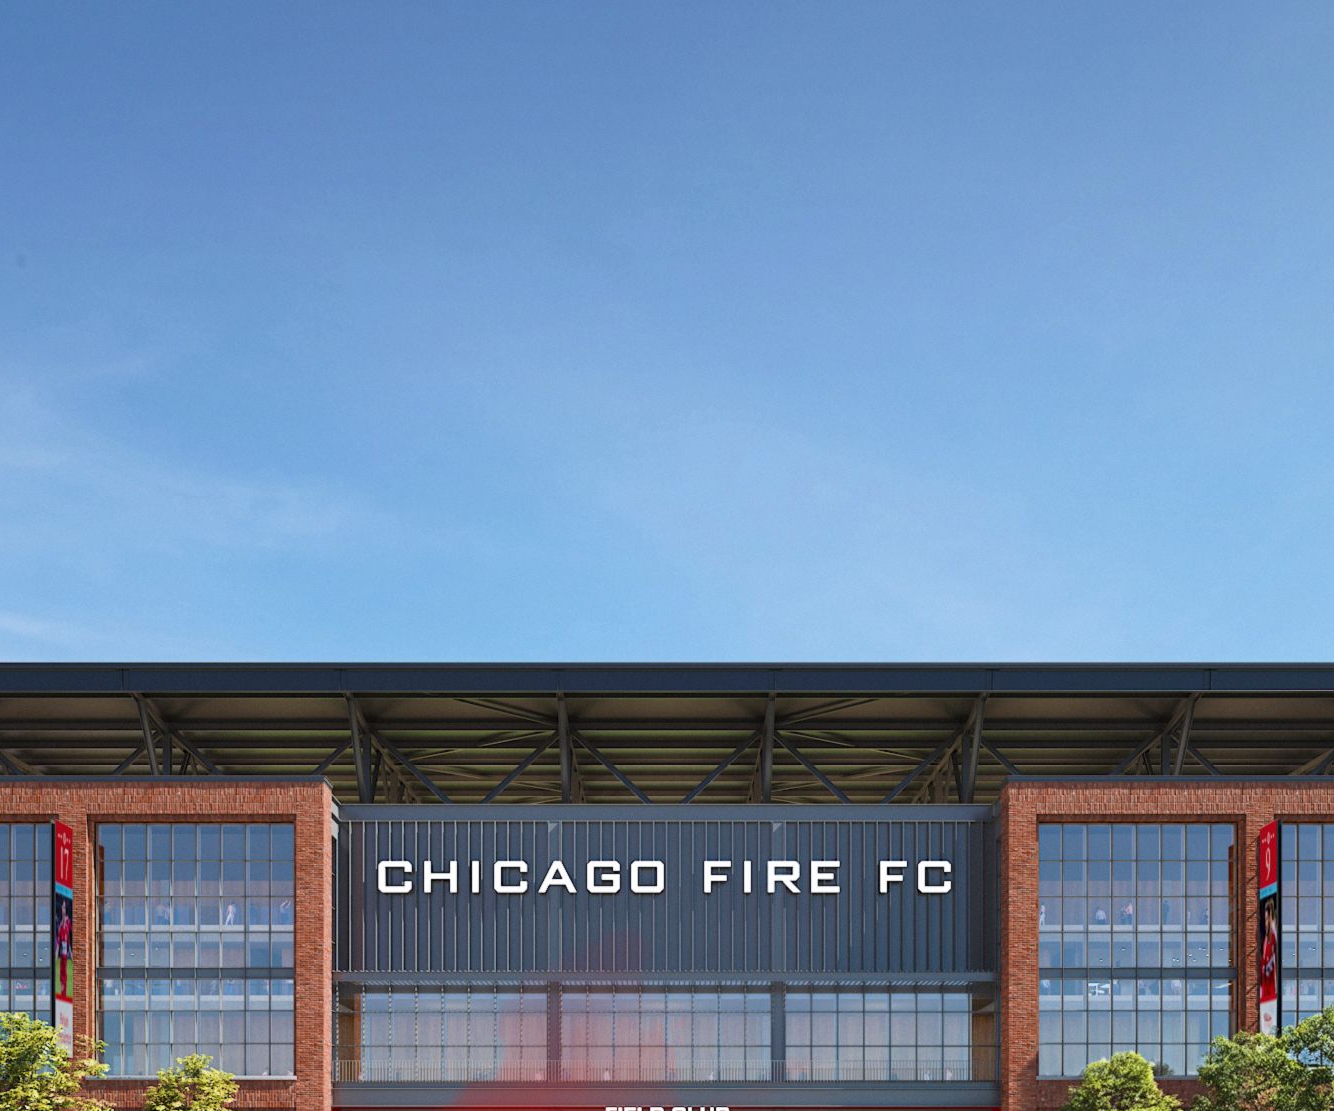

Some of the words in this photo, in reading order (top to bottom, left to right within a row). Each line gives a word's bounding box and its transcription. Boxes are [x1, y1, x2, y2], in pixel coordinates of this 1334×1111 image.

[377, 860, 666, 894] CHICAGO
[703, 860, 842, 894] FIRE
[879, 860, 953, 894] FC
[1265, 848, 1272, 881] 9
